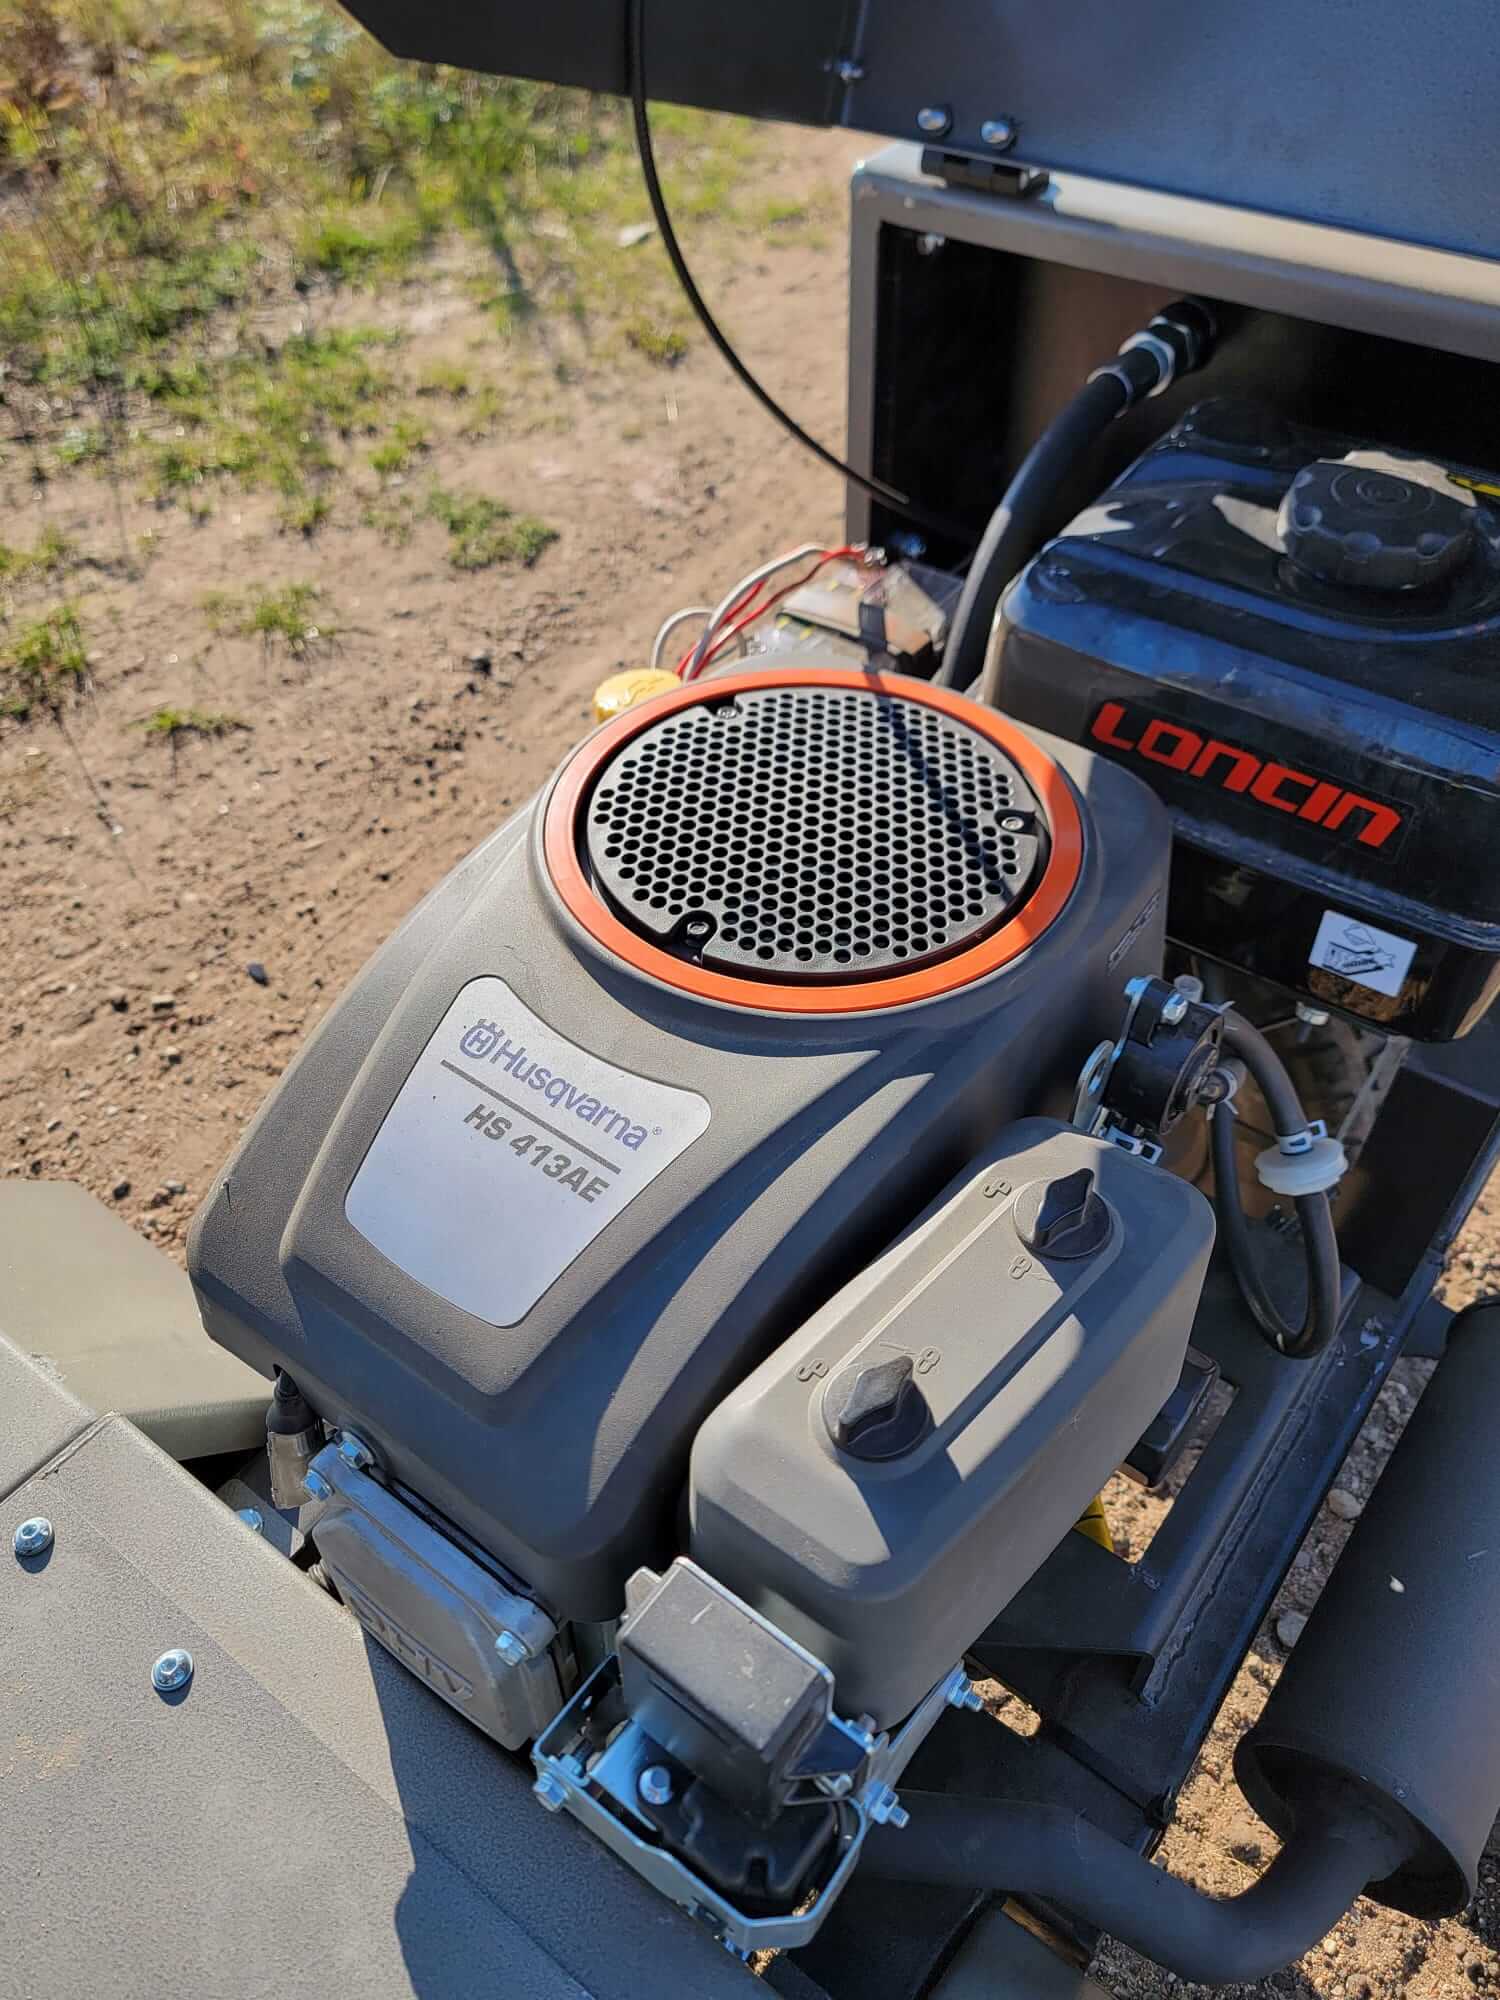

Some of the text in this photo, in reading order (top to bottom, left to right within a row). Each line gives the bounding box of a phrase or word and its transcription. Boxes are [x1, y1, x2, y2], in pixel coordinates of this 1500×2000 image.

[490, 1039, 648, 1151] Husqvarna
[463, 1103, 610, 1204] HS 413AE
